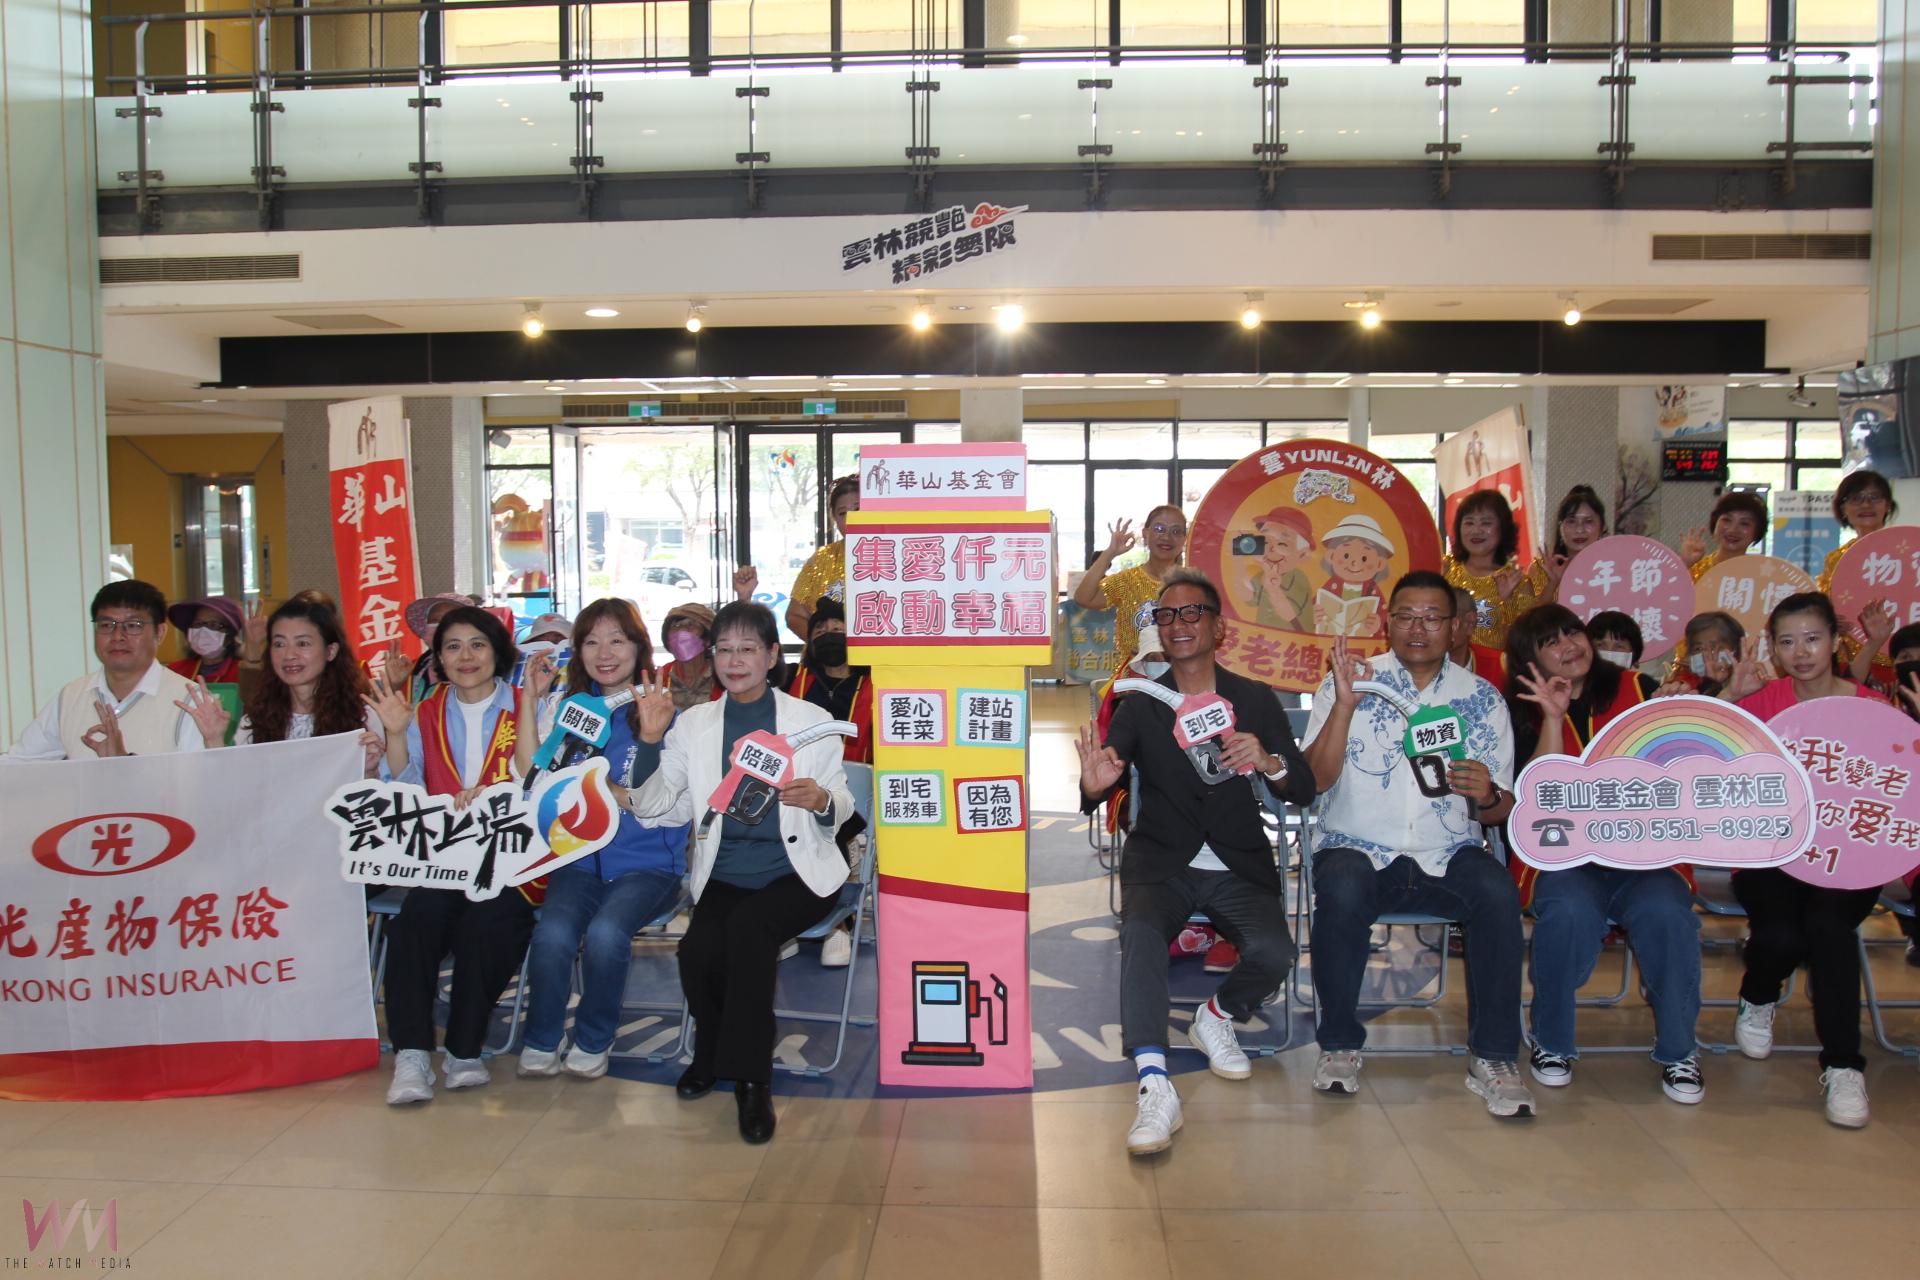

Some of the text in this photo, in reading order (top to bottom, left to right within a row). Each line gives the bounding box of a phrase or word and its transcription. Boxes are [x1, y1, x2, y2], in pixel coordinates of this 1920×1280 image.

[892, 220, 1016, 284] 精彩無限
[896, 468, 1020, 490] 華山基金會
[338, 472, 405, 532] 華山
[852, 535, 1047, 582] 集愛仟元
[1588, 558, 1663, 597] 年節
[853, 589, 1047, 636] 啟動幸福
[562, 706, 602, 737] 關懷
[890, 697, 934, 718] 愛心
[969, 697, 1013, 719] 建站
[891, 719, 935, 740] 年菜
[968, 719, 1013, 741] 計畫
[1184, 708, 1227, 738] 到宅
[1416, 721, 1457, 748] 物資
[496, 721, 518, 783] 華山
[740, 745, 783, 777] 陪醫
[888, 777, 931, 799] 到宅
[967, 784, 1012, 805] 因為
[1537, 775, 1789, 810] 華山基金會 雲林區
[884, 801, 938, 819] 服務車
[968, 805, 1013, 828] 有您
[91, 823, 134, 868] 光
[350, 860, 469, 882] It's Our Time
[1803, 847, 1840, 874] +1
[2, 957, 297, 1003] KONG INSURANCE
